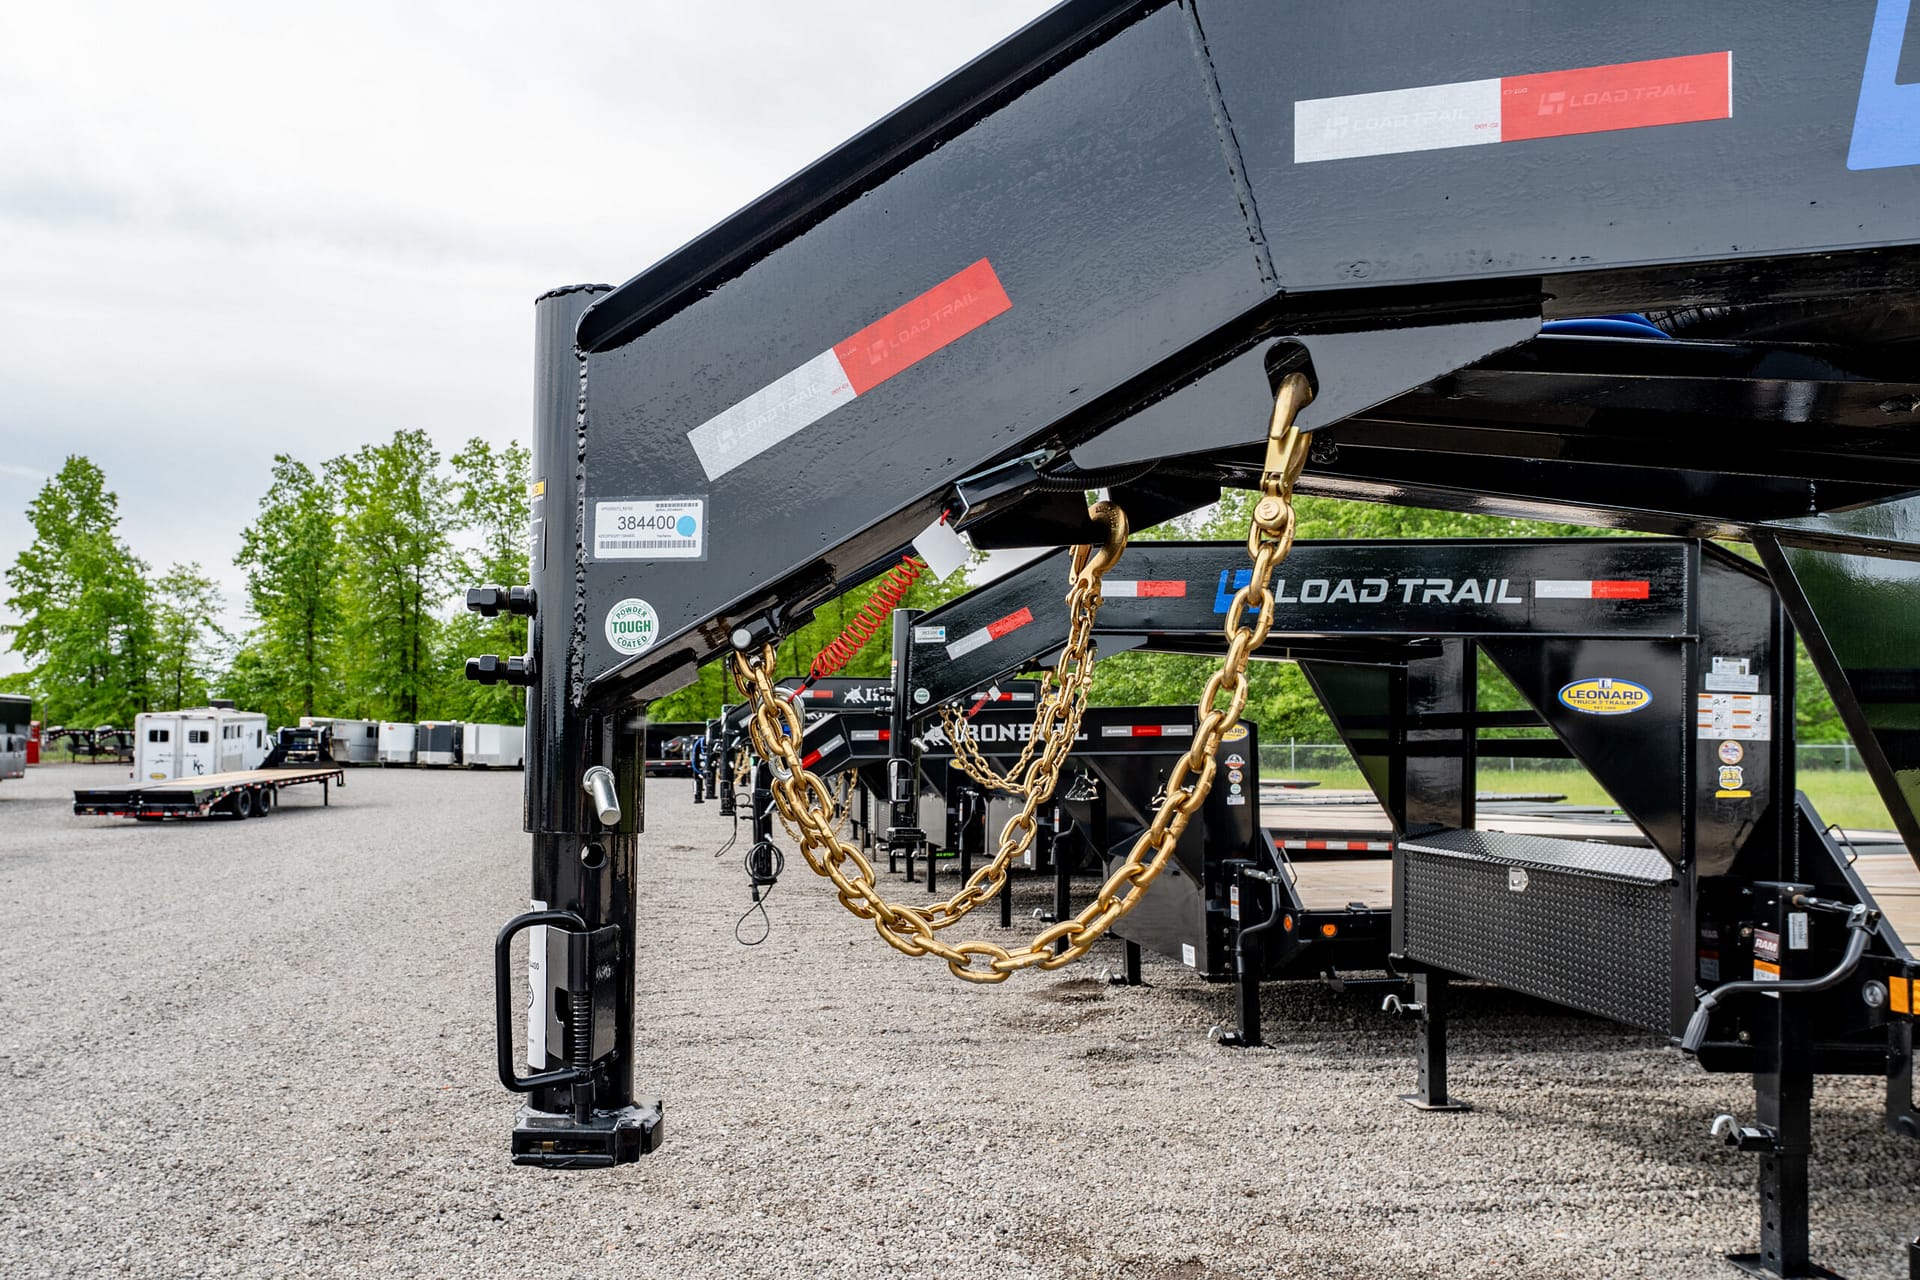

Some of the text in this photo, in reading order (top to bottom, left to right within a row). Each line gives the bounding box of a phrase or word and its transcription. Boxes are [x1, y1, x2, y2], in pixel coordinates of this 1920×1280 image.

[1570, 82, 1697, 108] LOAD TRAIL
[931, 291, 979, 323] TRAIL
[617, 515, 676, 530] 384400
[1275, 578, 1523, 604] LOAD TRAIL
[615, 605, 648, 619] POWDER
[612, 619, 651, 634] TOUGH
[616, 635, 648, 649] COATED
[1567, 689, 1643, 700] LEONARD
[1754, 938, 1778, 952] RAM
